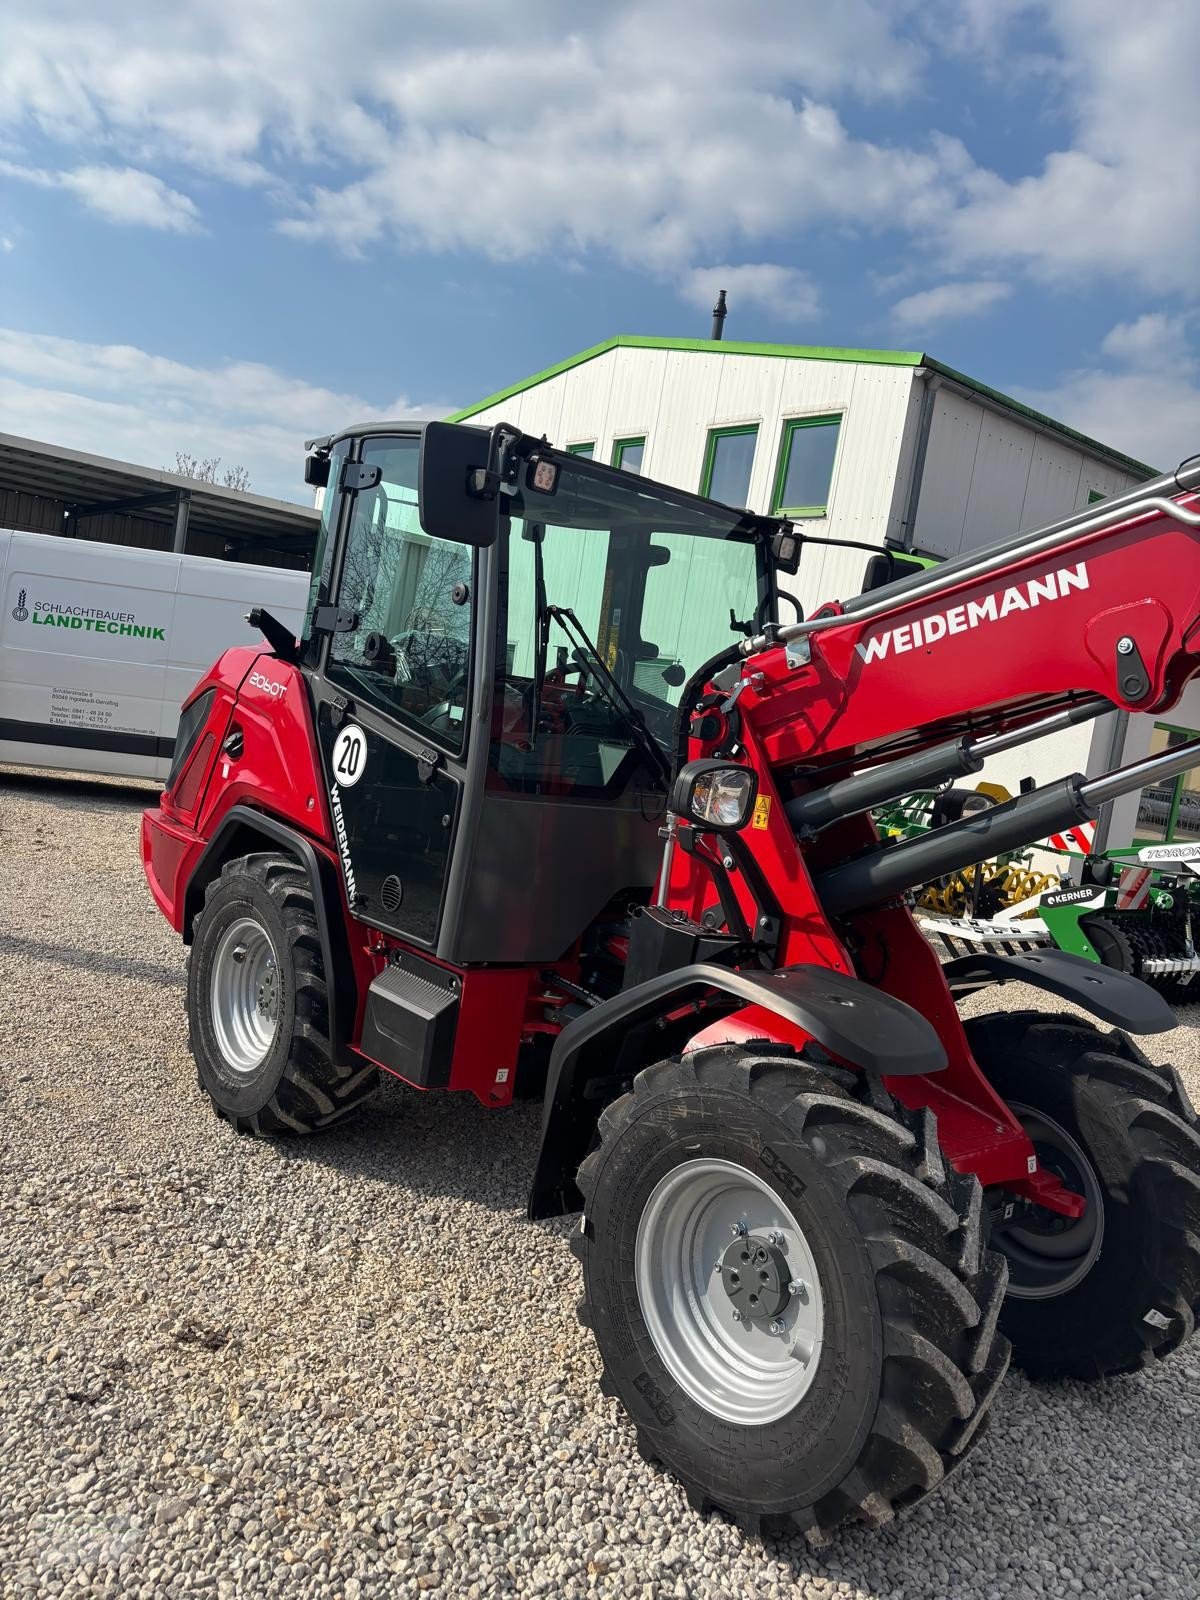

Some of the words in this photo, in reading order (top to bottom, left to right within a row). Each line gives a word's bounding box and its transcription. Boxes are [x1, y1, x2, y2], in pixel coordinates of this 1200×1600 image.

[32, 611, 166, 641] LANDTECHNIK
[33, 601, 136, 624] SCHLACHTBAUER
[854, 561, 1090, 665] WEIDEMANN
[337, 734, 361, 777] 20
[330, 782, 358, 909] WEIDEMANN
[1055, 888, 1093, 904] KERNER
